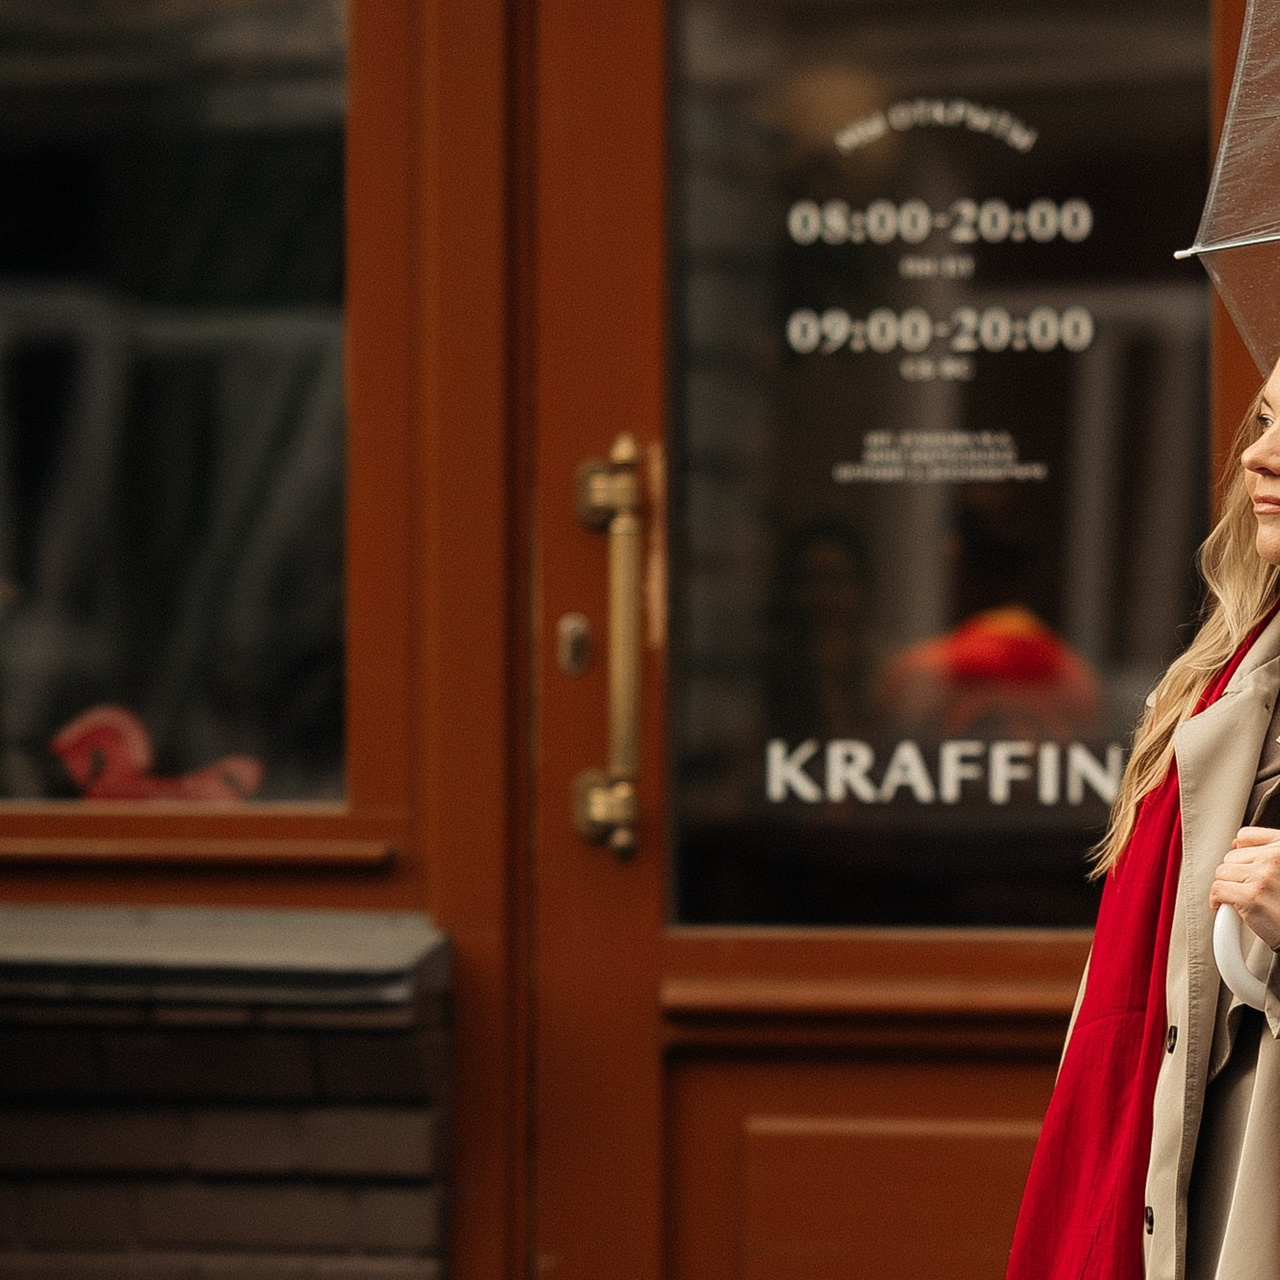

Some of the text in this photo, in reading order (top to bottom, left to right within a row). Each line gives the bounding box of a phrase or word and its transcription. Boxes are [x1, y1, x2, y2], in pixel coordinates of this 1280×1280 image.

[787, 199, 1093, 244] 08:00-20:00
[787, 306, 1094, 353] 09:00-20:00
[766, 738, 1124, 806] KRAFFIN
